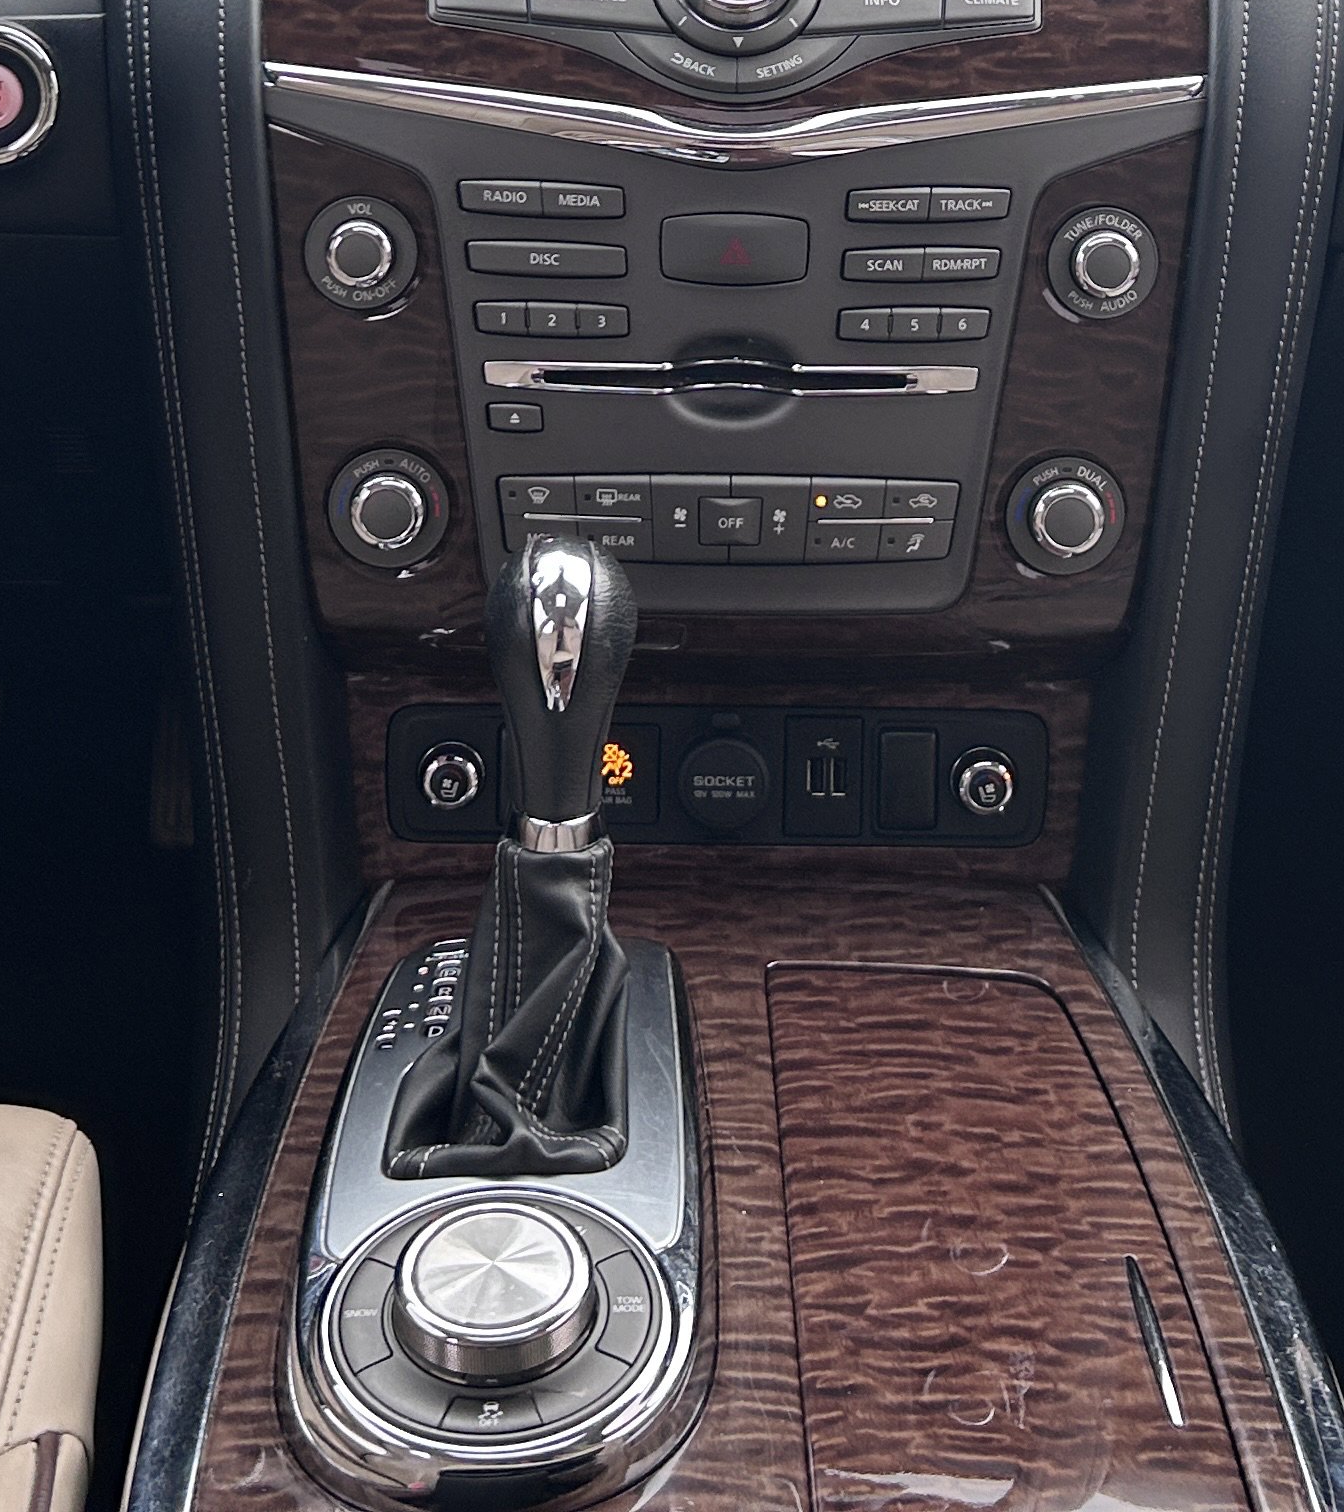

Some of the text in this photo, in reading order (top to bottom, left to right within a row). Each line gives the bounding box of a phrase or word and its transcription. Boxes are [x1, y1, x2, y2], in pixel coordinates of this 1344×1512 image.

[682, 56, 717, 77] BACK
[756, 54, 803, 79] SETTING
[483, 189, 527, 204] RADIO
[558, 193, 601, 208] MEDIA
[347, 203, 373, 217] VOL
[940, 199, 982, 211] TRACK
[1063, 214, 1143, 244] TUNE/FOLDER
[530, 253, 561, 266] DISC
[866, 258, 904, 272] SCAN
[321, 275, 348, 299] PUSH
[1067, 289, 1138, 312] PUSH AUDIO
[500, 313, 507, 325] 1
[547, 314, 557, 327] 2
[597, 315, 606, 328] 3
[860, 319, 870, 331] 4
[910, 319, 919, 331] 5
[958, 318, 967, 331] 6
[353, 458, 431, 484] PUSH AUTO
[1032, 465, 1107, 491] PUSH DUAL
[618, 493, 641, 501] REAR
[718, 517, 744, 529] OFF
[602, 535, 635, 546] REAR
[830, 537, 855, 549] A/C
[693, 775, 755, 787] SOCKET
[605, 788, 626, 796] PASS
[438, 987, 452, 996] R
[428, 1026, 444, 1037] D
[616, 1295, 644, 1304] TOW
[344, 1308, 379, 1318] SNOW
[612, 1304, 645, 1313] MODE
[478, 1418, 500, 1428] OFF
